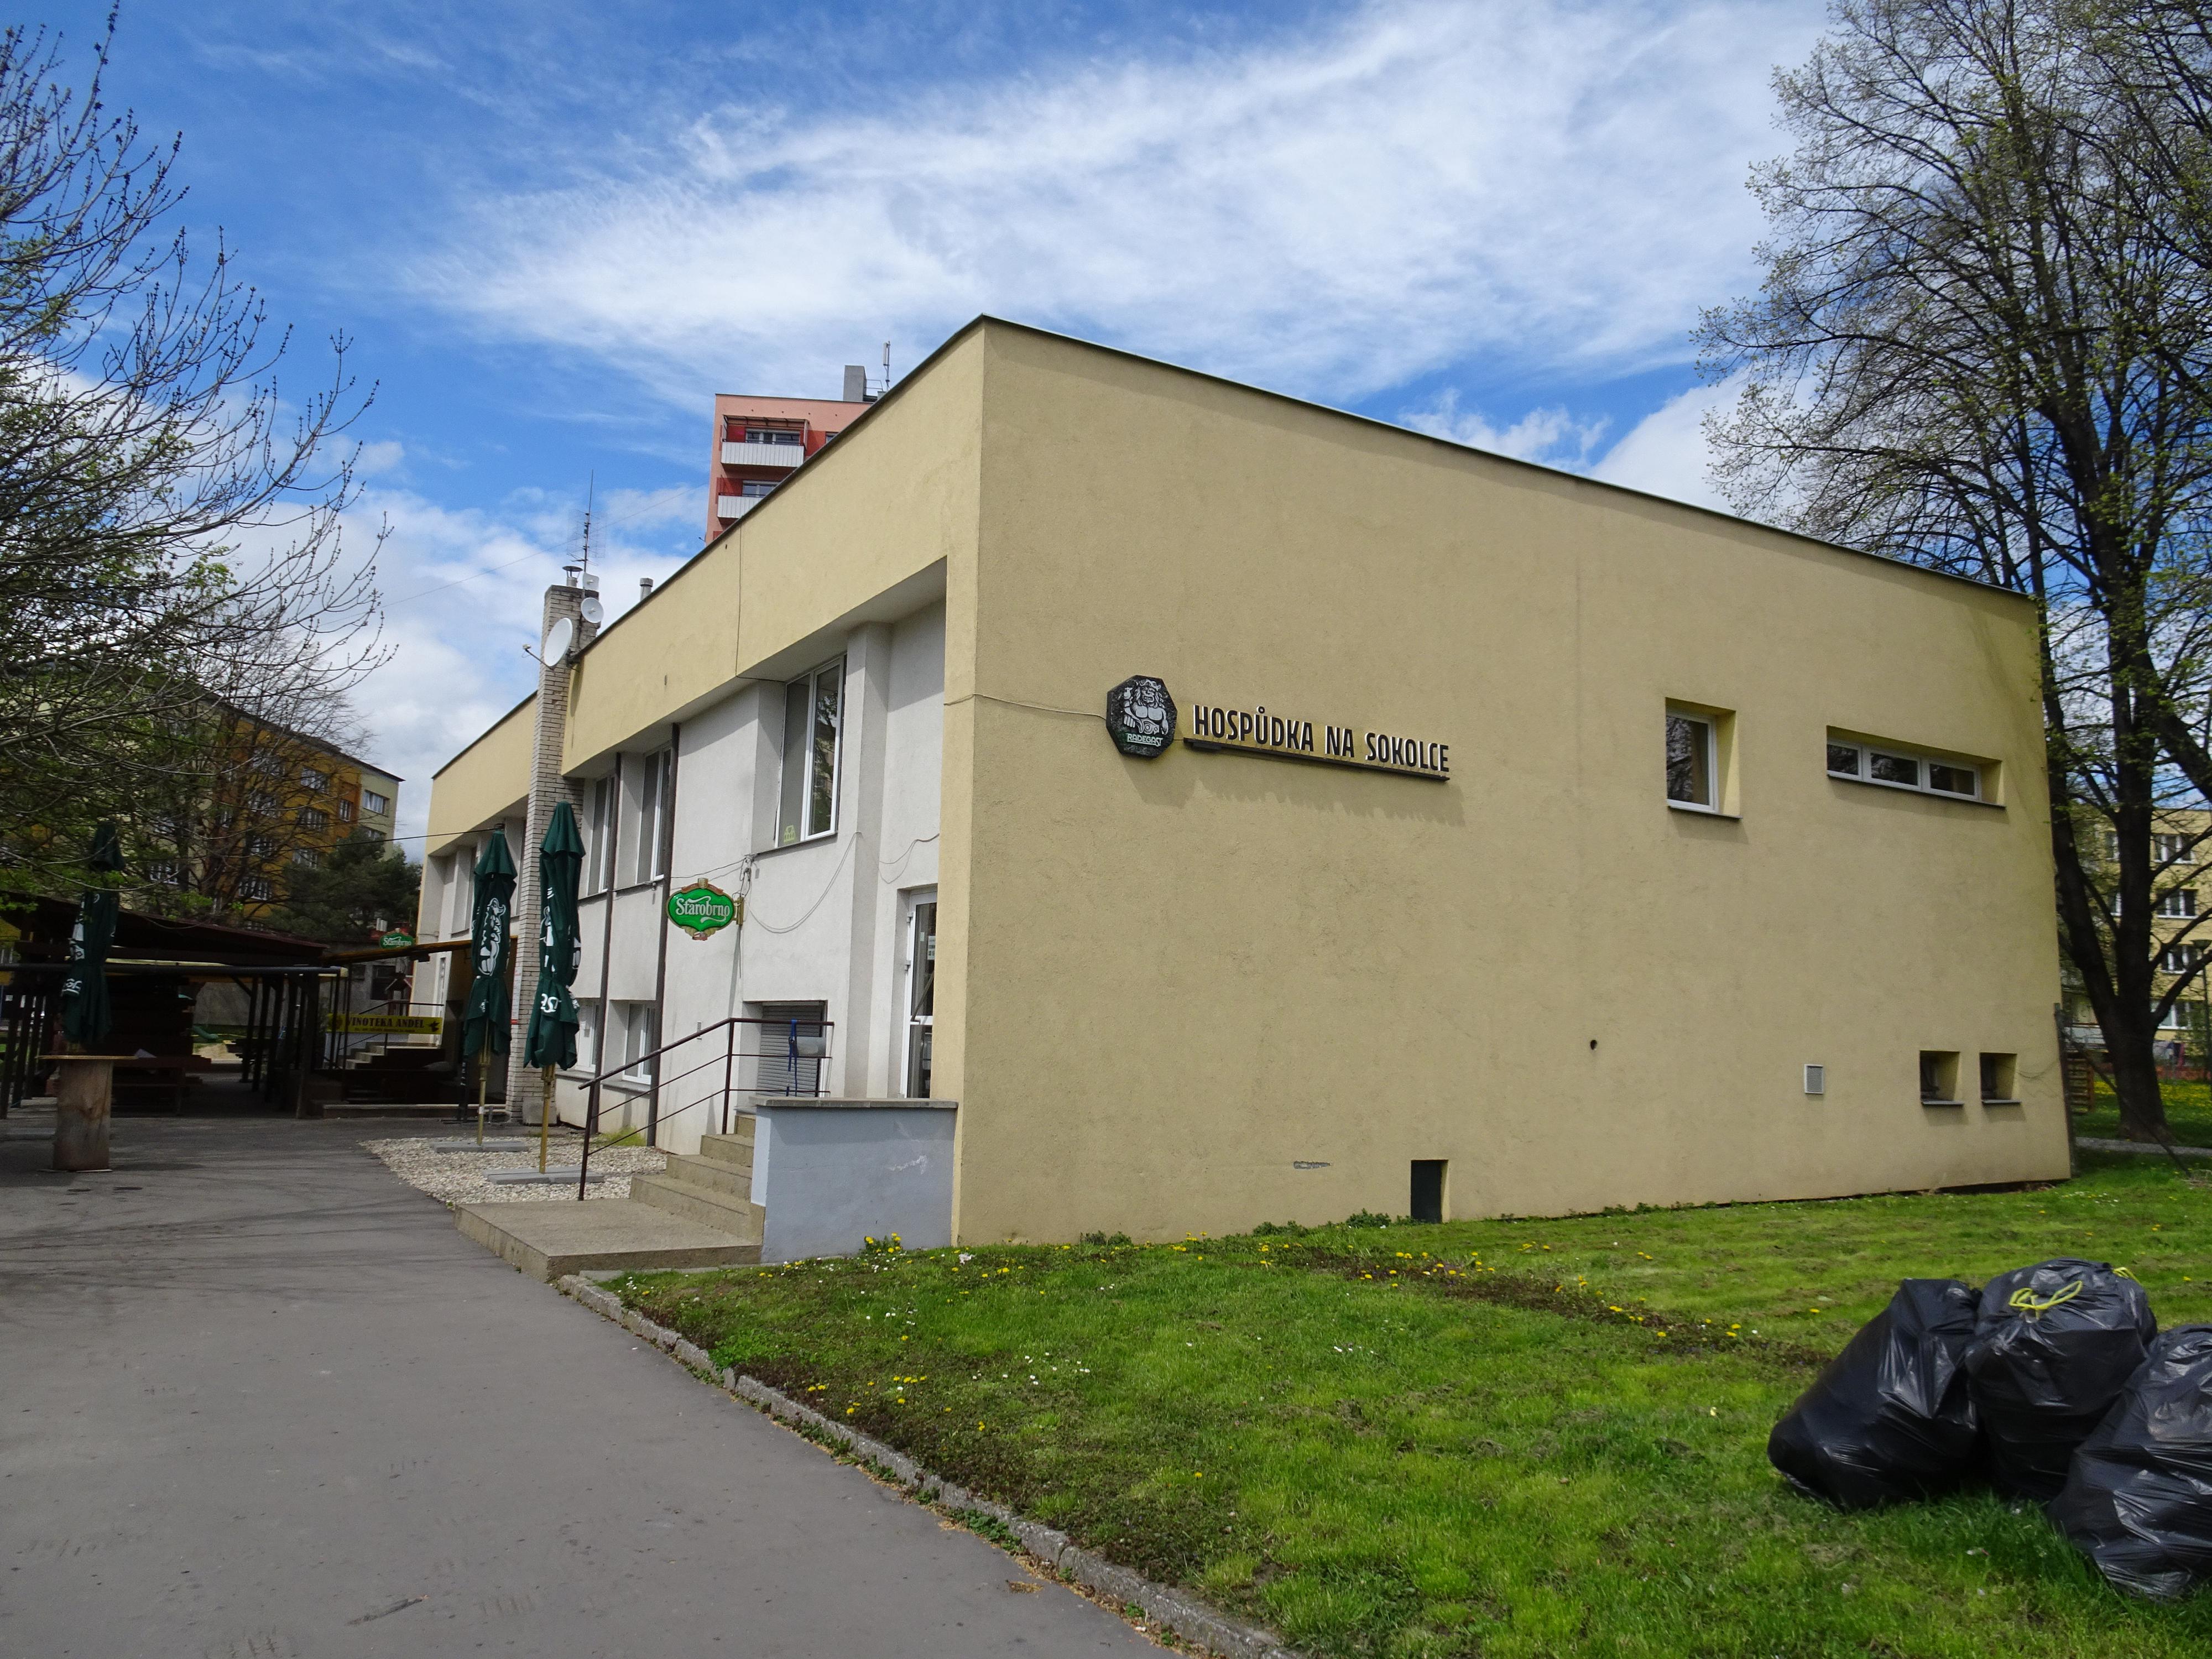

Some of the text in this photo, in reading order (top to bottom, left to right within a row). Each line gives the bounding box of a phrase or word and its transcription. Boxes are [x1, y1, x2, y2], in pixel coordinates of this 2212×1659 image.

[1126, 733, 1164, 747] RADEGAST
[1193, 705, 1450, 773] HOSPŮDKA NA SOKOLCE
[675, 895, 731, 924] Starobrno
